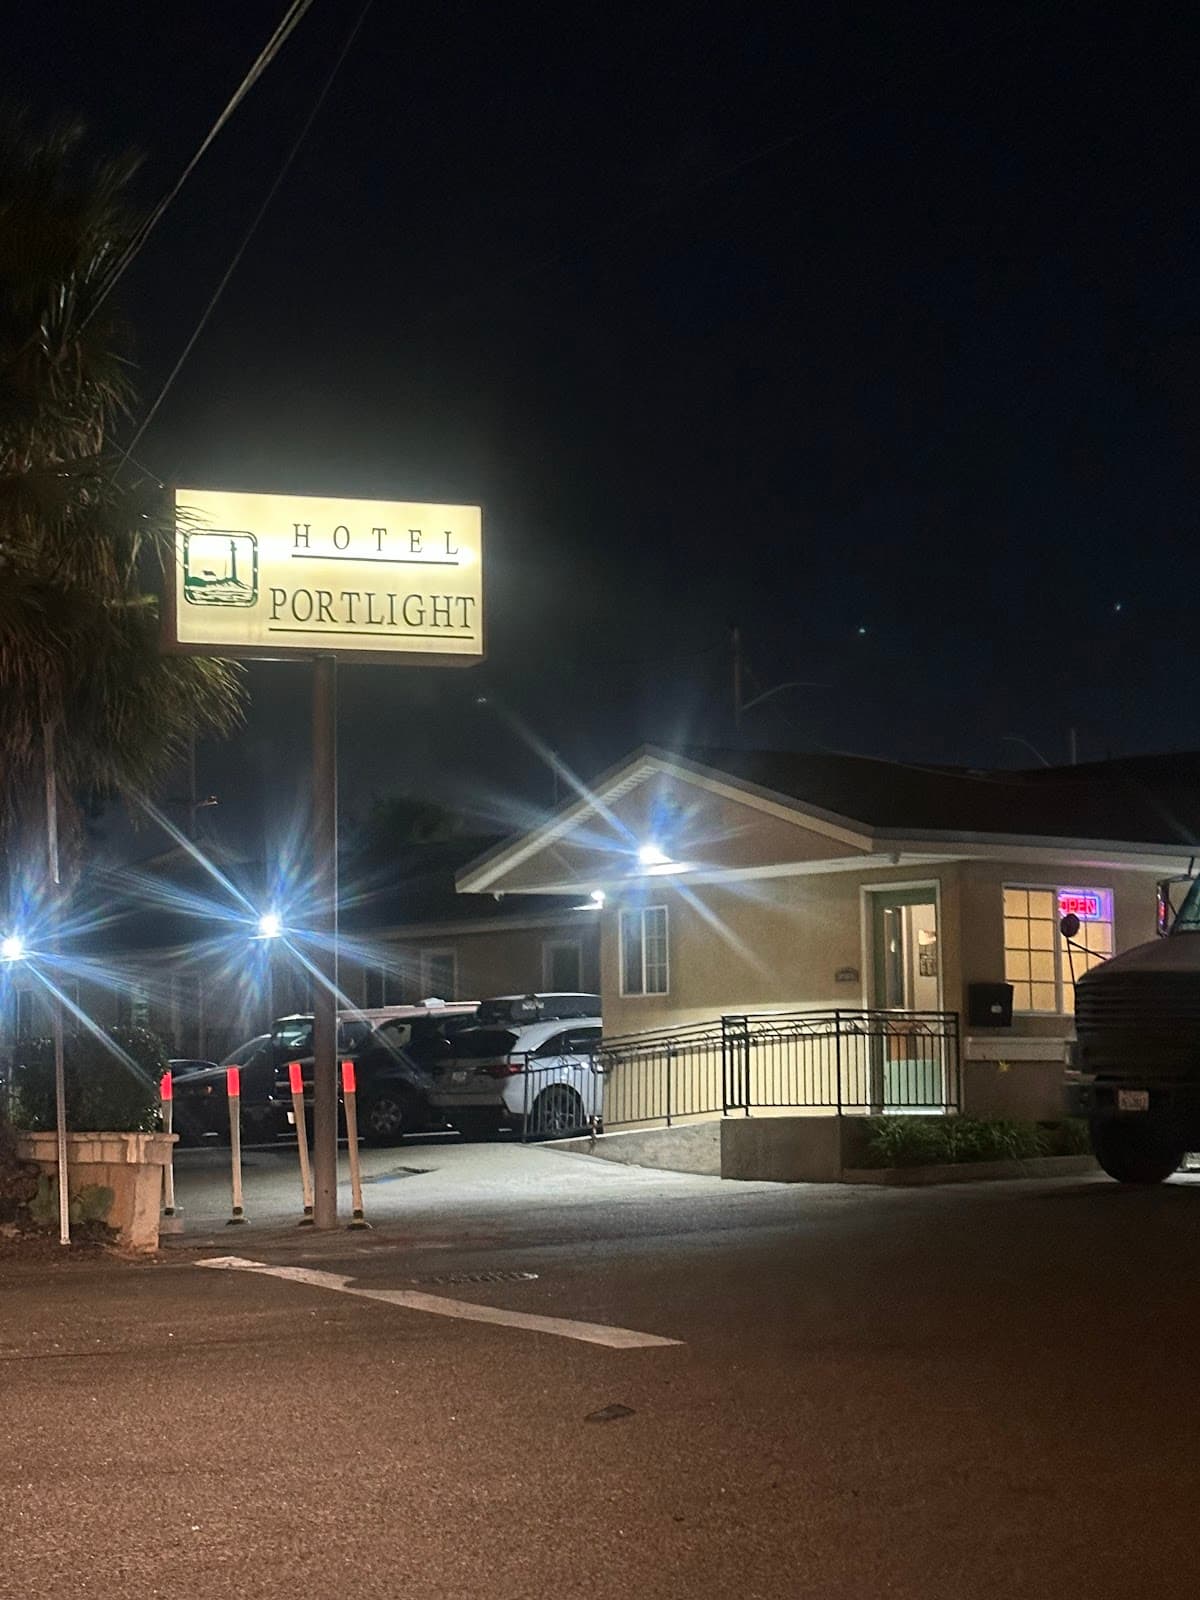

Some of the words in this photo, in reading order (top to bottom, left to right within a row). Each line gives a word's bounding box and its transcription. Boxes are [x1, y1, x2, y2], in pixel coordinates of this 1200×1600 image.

[293, 523, 459, 555] HOTEL
[268, 587, 475, 629] PORTLIGHT
[1059, 897, 1096, 913] OPEN
